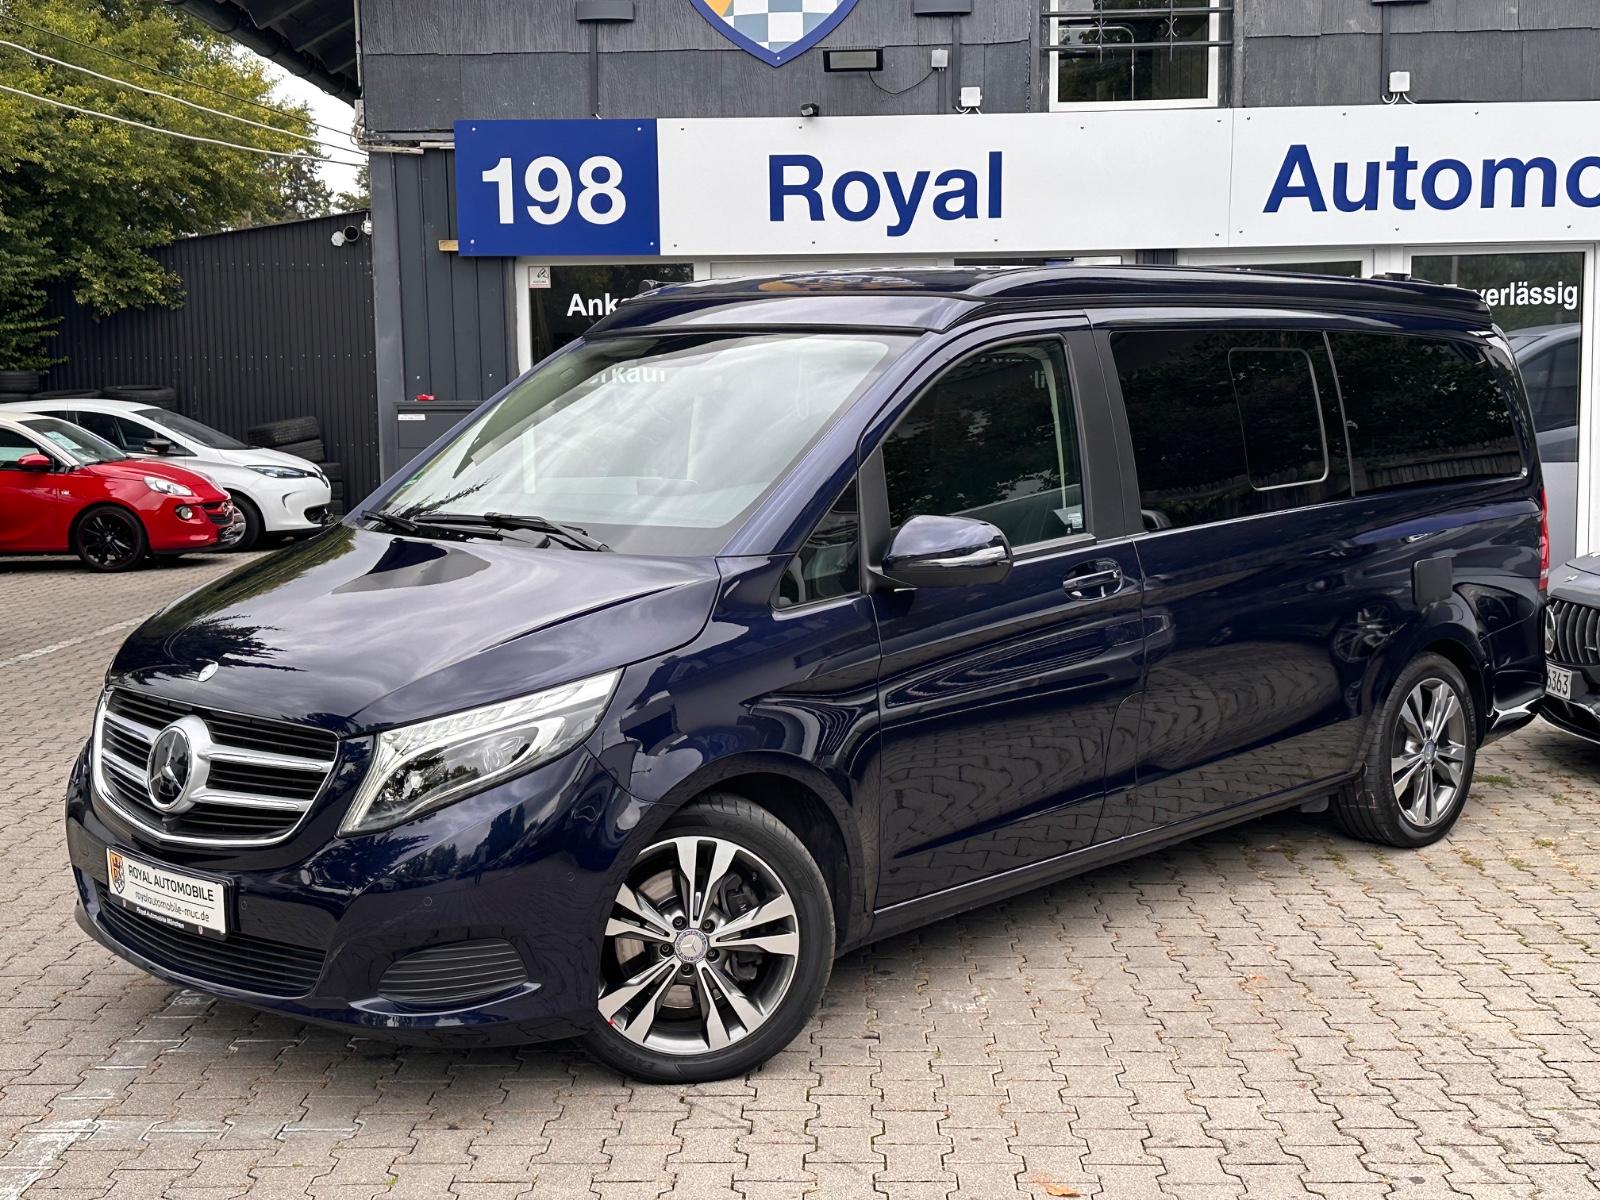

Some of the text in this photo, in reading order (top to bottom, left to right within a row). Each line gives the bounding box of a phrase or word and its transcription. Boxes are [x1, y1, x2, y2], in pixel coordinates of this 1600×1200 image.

[482, 155, 627, 225] 198
[768, 143, 1600, 237] Royal Automo
[566, 292, 629, 316] Ank
[128, 864, 215, 902] ROYAL AUTOMOBILE
